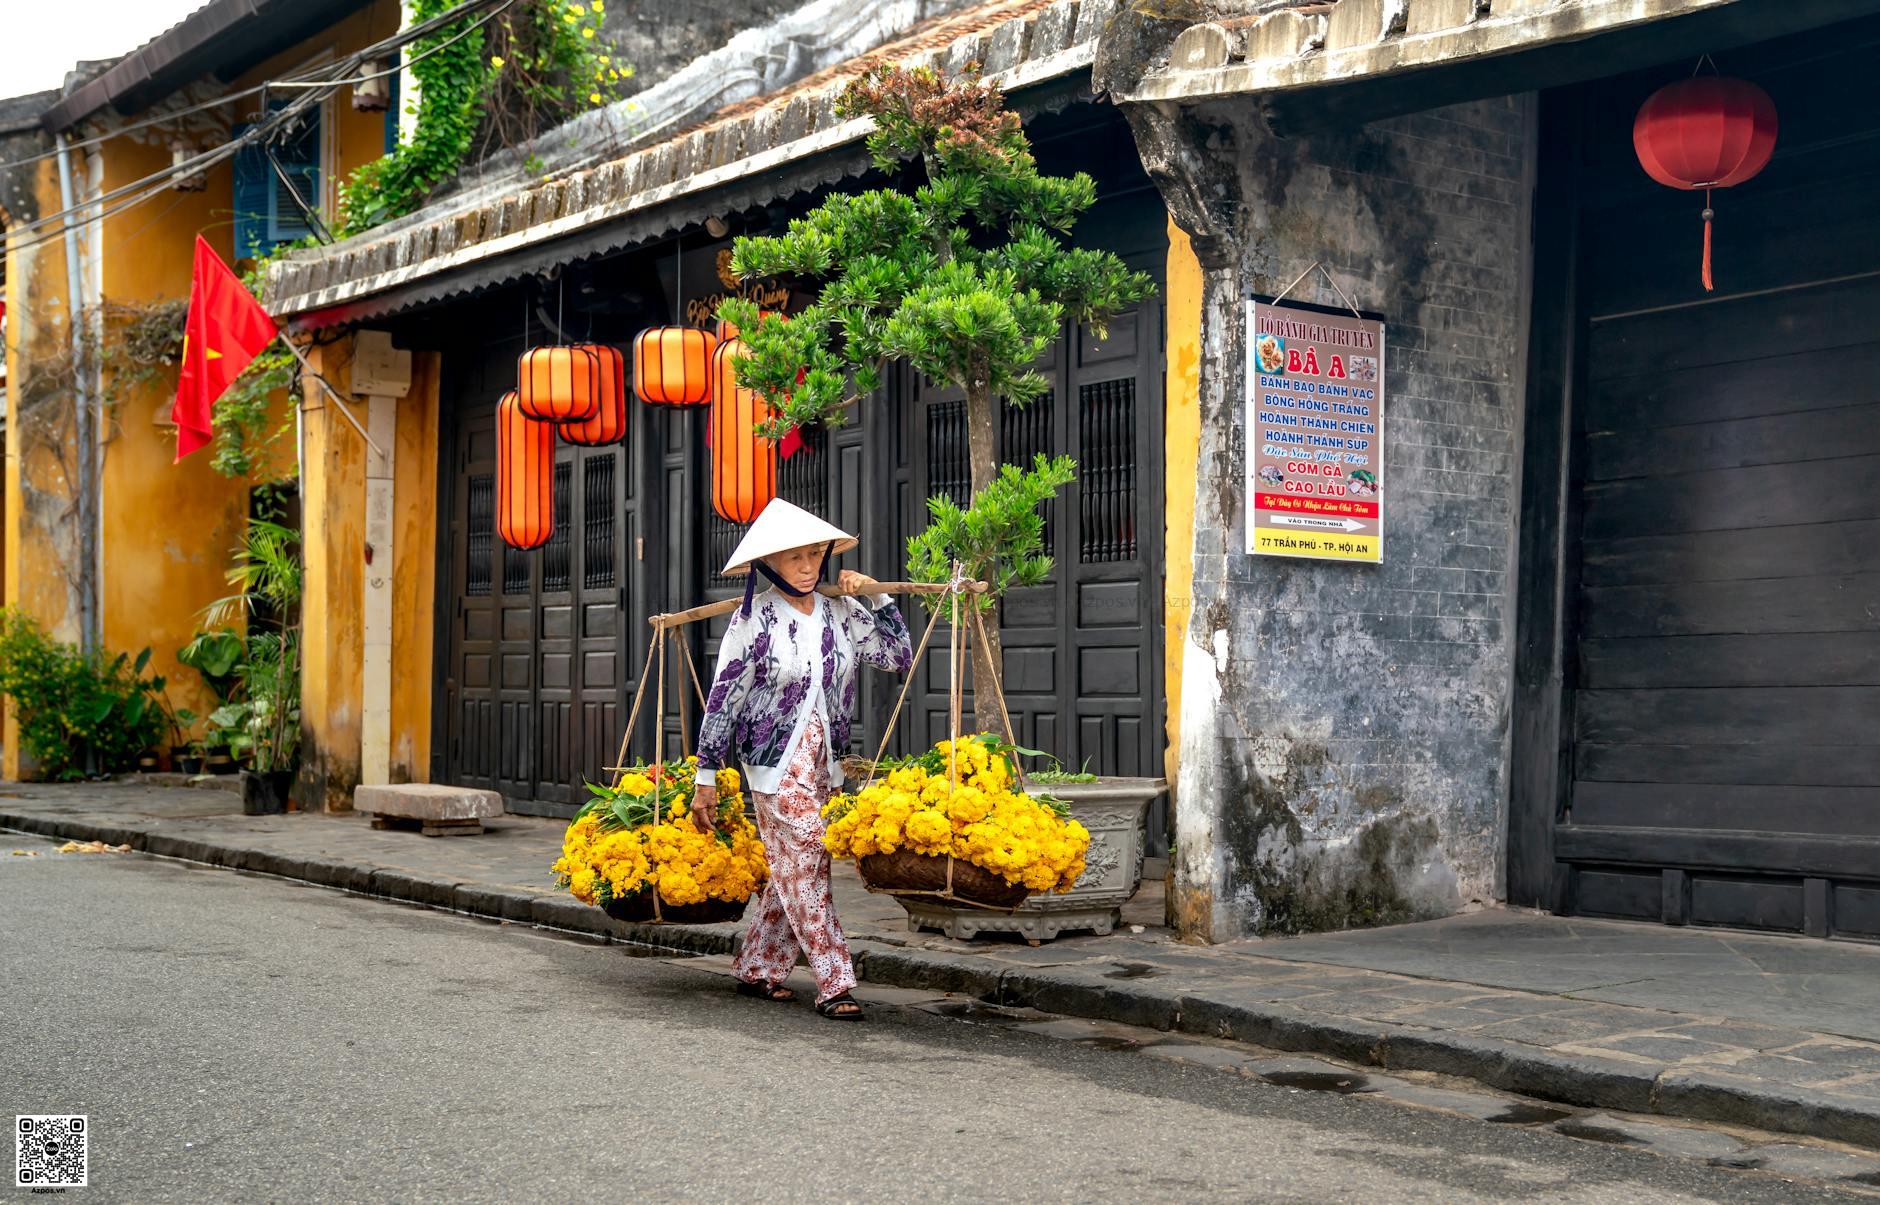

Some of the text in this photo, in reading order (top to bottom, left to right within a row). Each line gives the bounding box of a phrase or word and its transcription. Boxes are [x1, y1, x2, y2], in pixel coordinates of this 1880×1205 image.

[1276, 315, 1306, 340] BÁNH
[1309, 324, 1328, 343] GIA
[1287, 347, 1346, 379] BÀ A
[1261, 375, 1290, 390] BÁNH
[1294, 381, 1315, 392] BAO
[1352, 388, 1374, 402] VẠC
[1265, 393, 1369, 416] BÔNG HỒNG TRẮNG
[1260, 410, 1297, 426] HOÀNH
[1287, 460, 1343, 477] CƠM GÀ
[1284, 480, 1346, 497] CAO LẦU
[1261, 537, 1271, 547] 77
[1299, 538, 1317, 550] PHÚ
[1323, 542, 1337, 552] TP.
[1338, 541, 1354, 555] HỘI
[1355, 544, 1368, 553] AN
